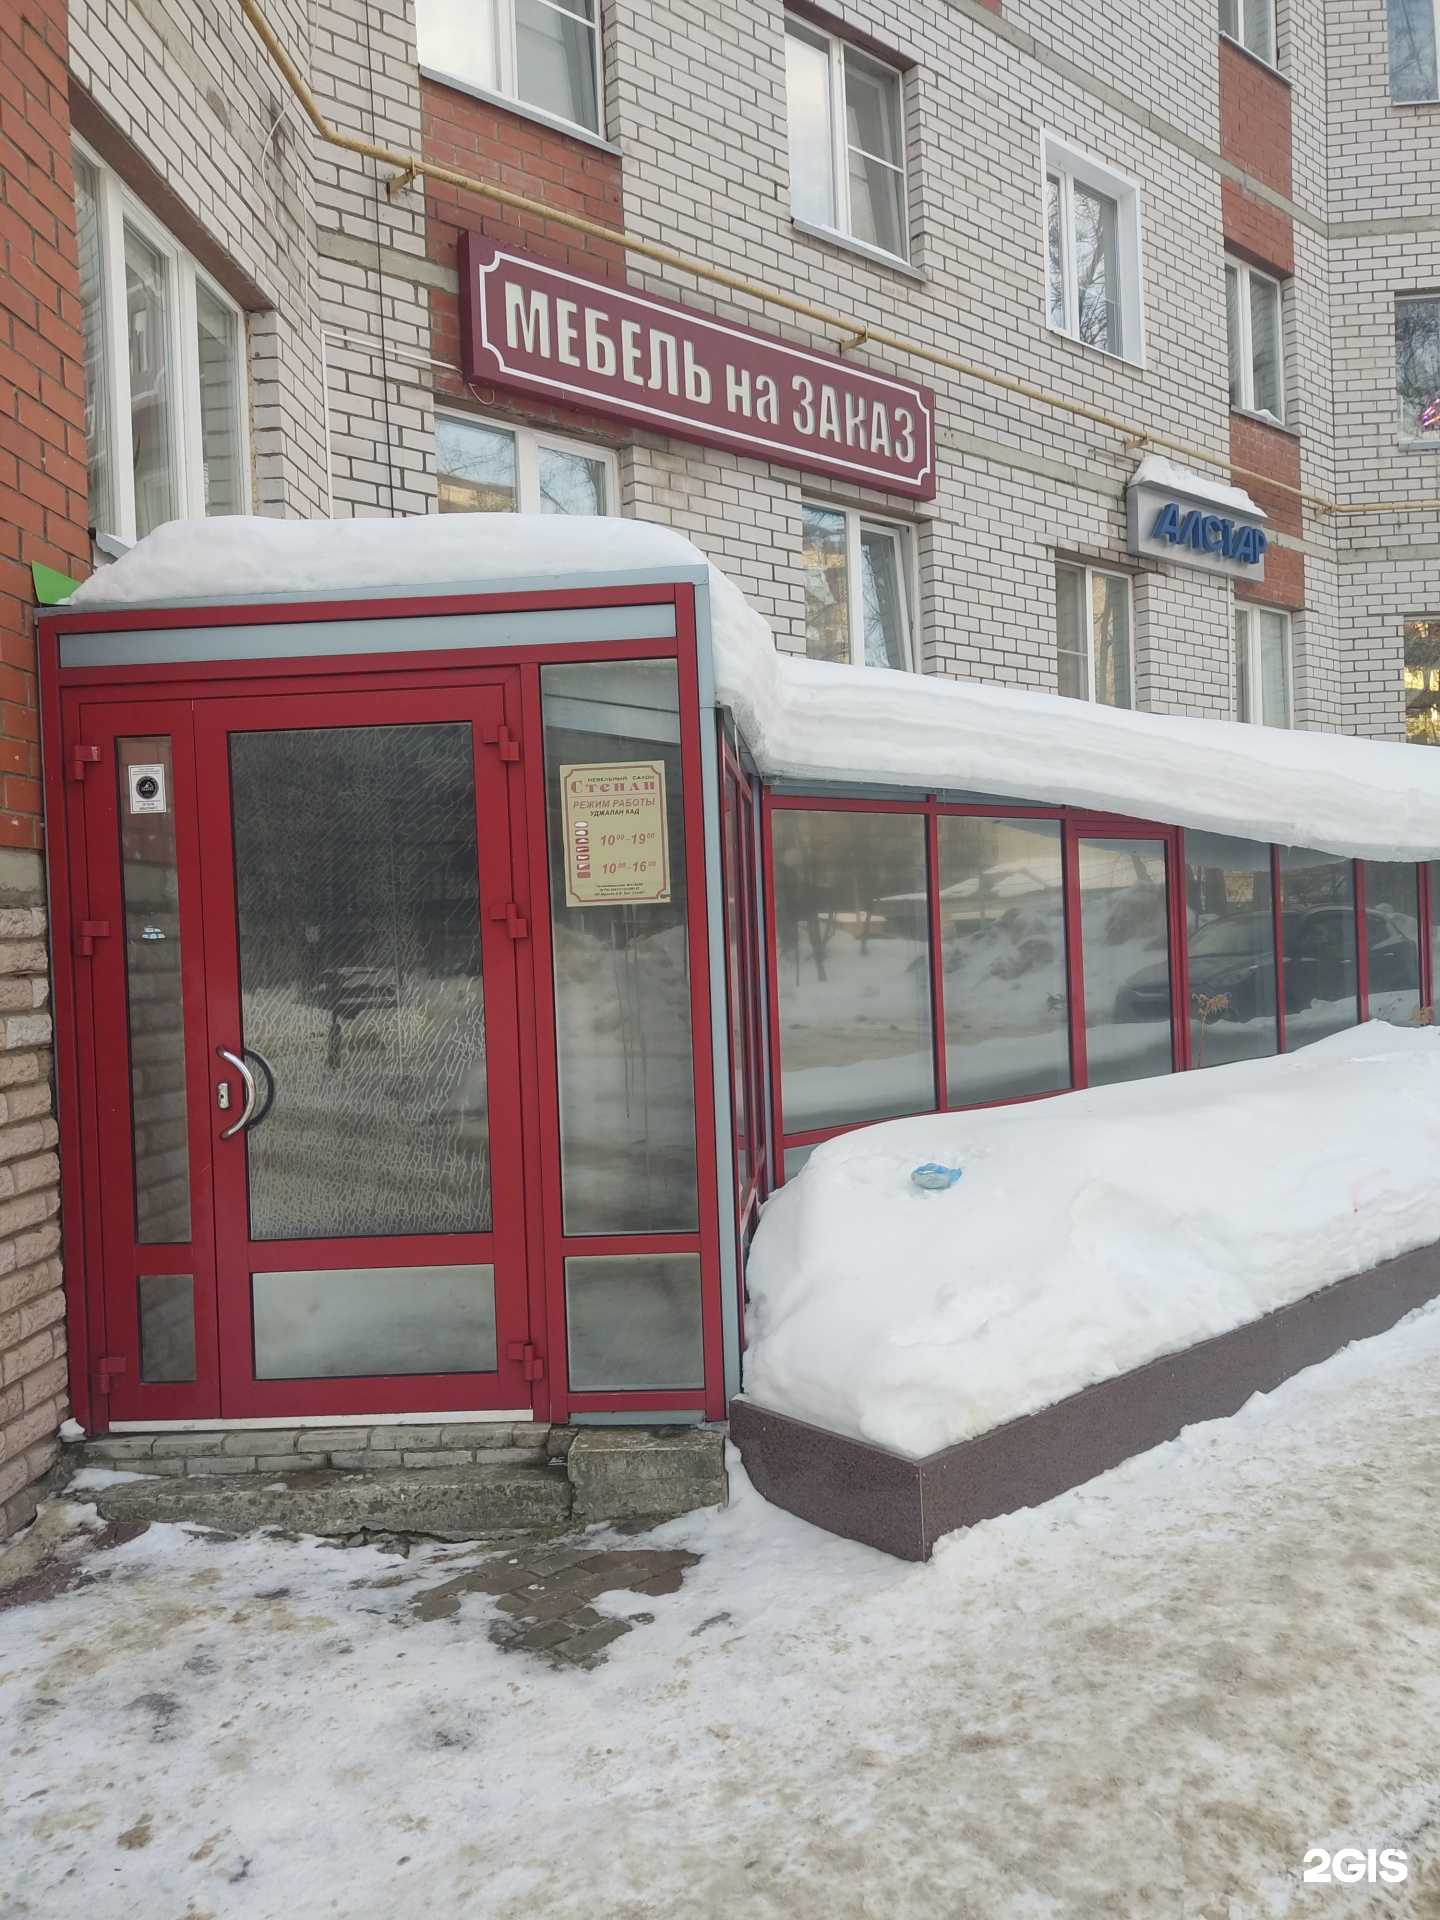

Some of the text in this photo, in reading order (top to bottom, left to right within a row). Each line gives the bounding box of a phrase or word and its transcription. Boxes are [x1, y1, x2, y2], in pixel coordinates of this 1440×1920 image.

[504, 281, 916, 464] МЕБЕЛЬ на ЗАКАЗ
[1151, 502, 1268, 565] АЛСТАР
[573, 798, 657, 809] РЕЖИМ РАБОТЫ
